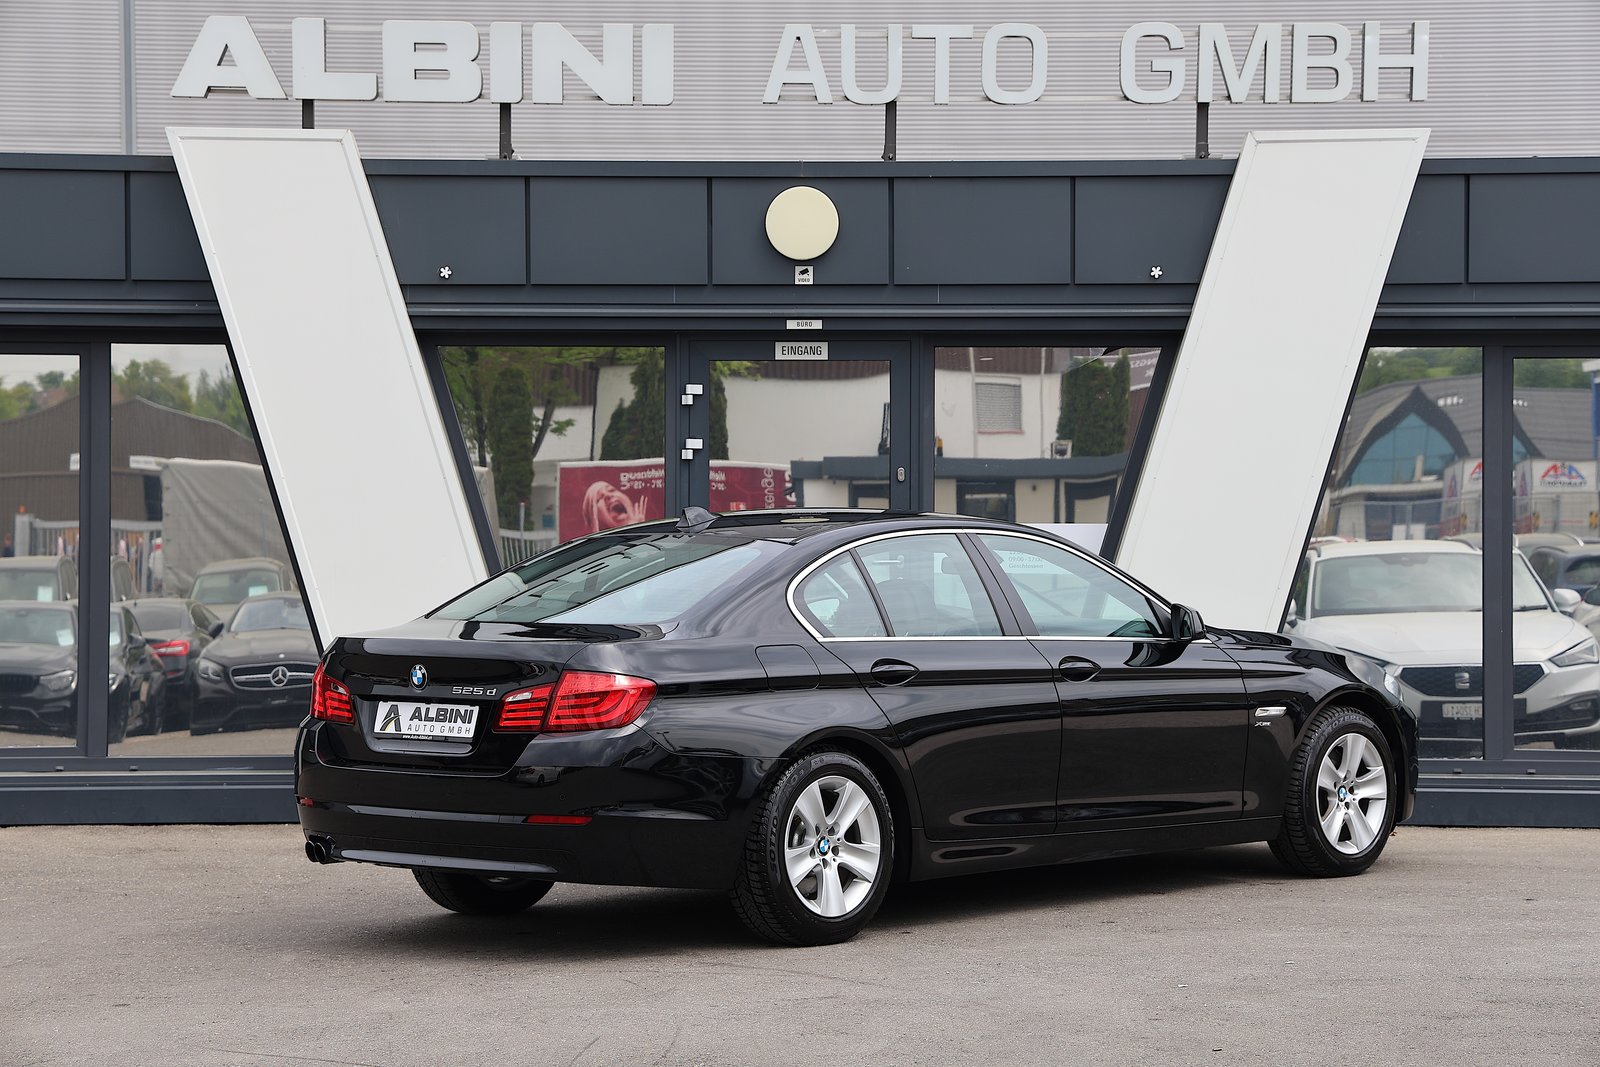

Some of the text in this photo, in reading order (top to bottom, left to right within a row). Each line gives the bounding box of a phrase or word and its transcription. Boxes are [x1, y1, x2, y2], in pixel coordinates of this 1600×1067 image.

[171, 15, 1430, 106] ALBINI AUTO GMBH
[781, 345, 822, 356] EINGANG
[409, 706, 475, 724] ALBINI
[407, 723, 471, 734] AUTO GMBH
